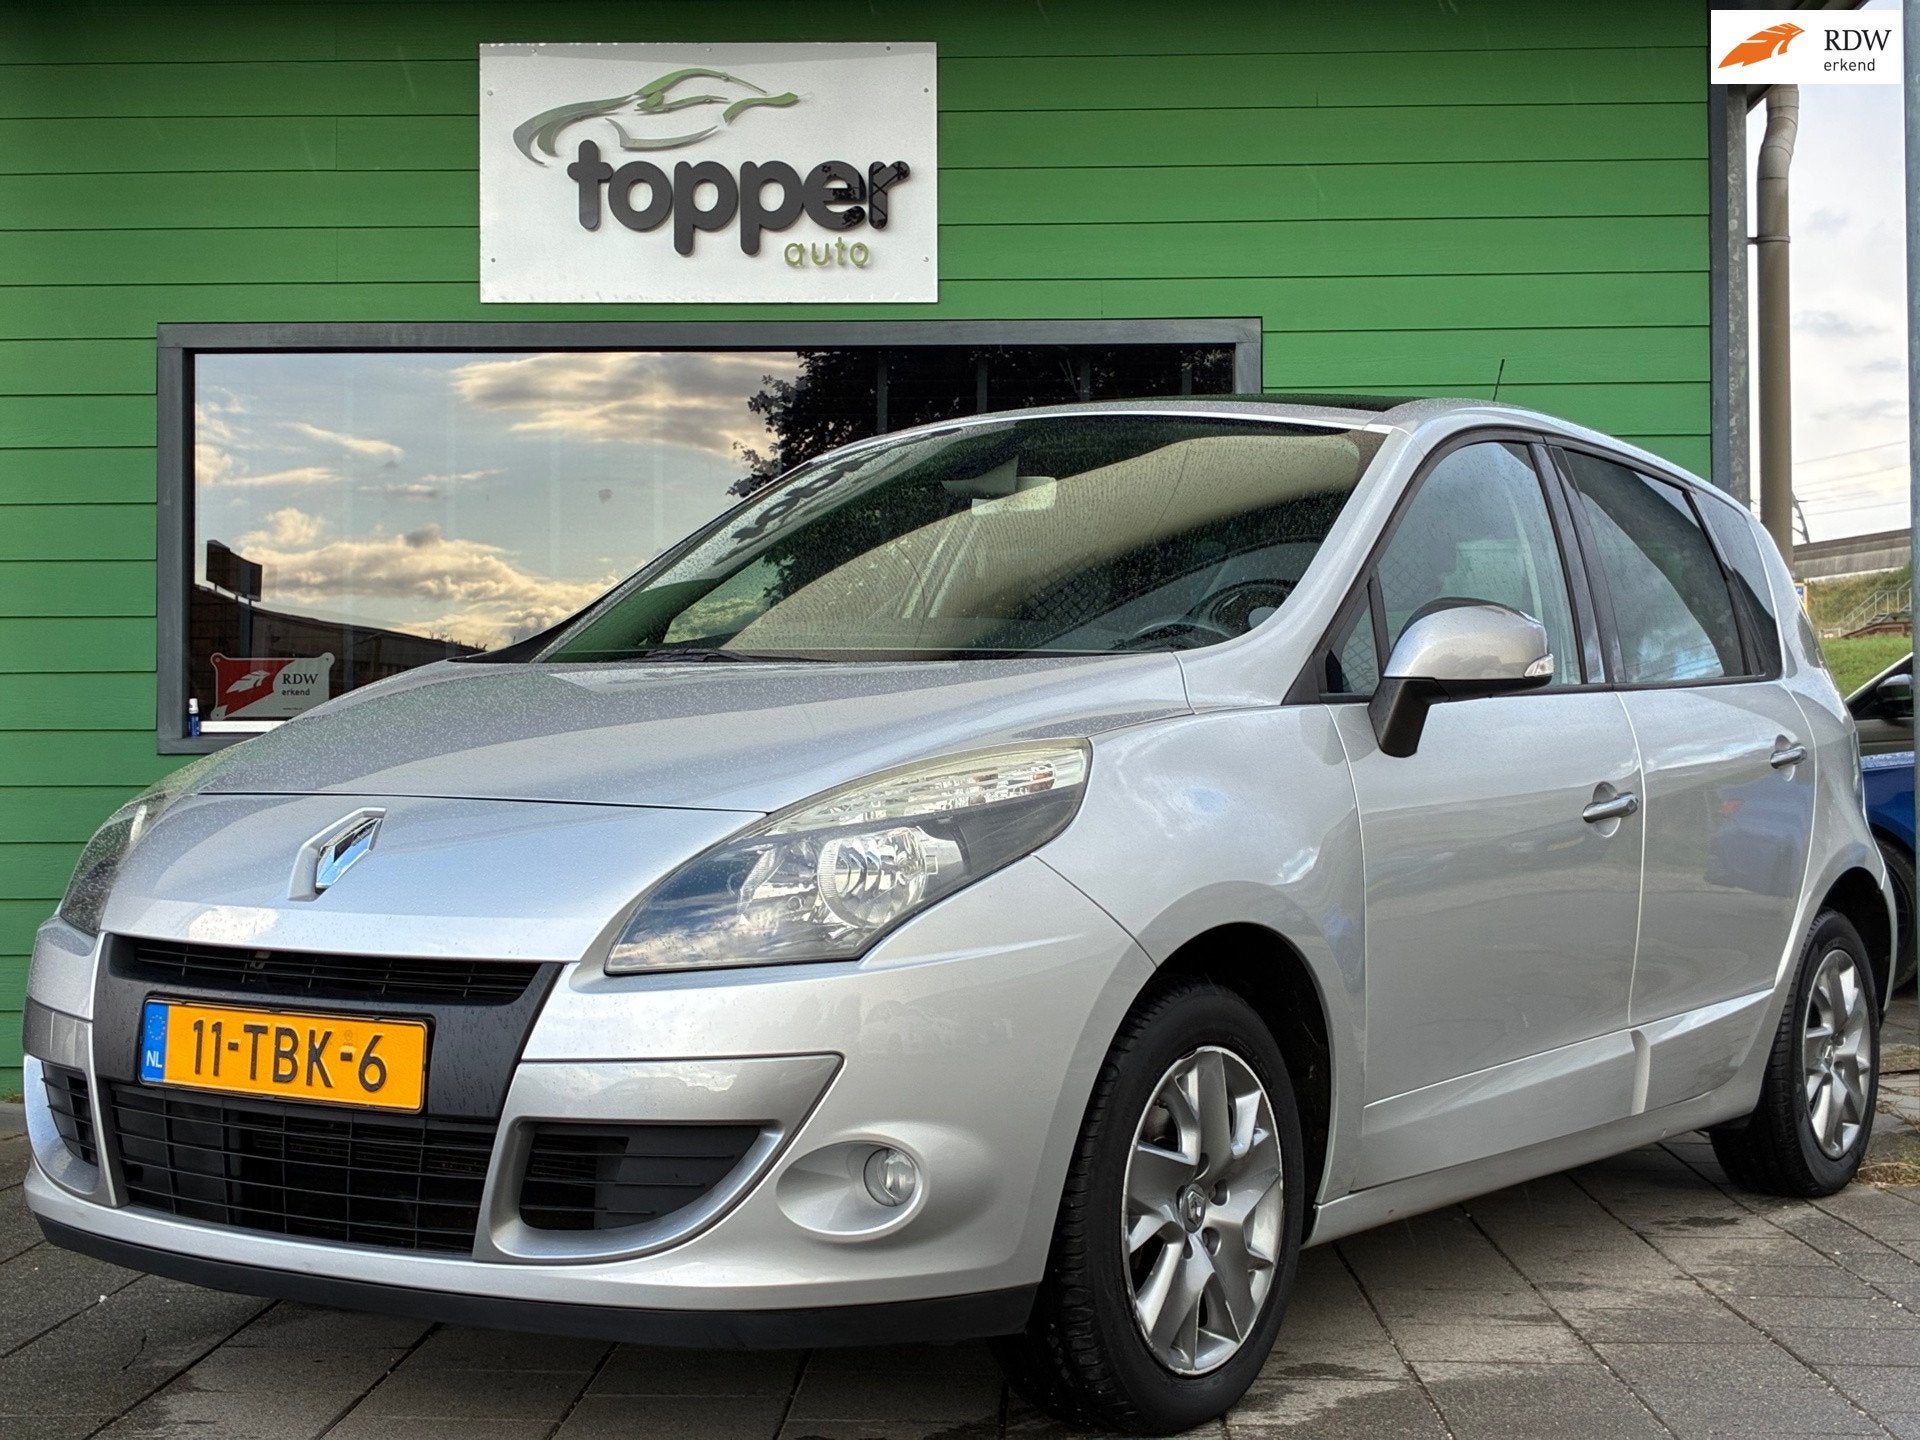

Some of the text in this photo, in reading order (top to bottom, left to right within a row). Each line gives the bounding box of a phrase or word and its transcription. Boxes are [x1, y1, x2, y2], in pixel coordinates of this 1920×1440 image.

[567, 139, 910, 256] topper
[784, 236, 870, 267] auto
[282, 673, 318, 685] RDW
[282, 688, 310, 696] erkend
[146, 1050, 163, 1069] NL
[192, 1019, 387, 1093] 11-TBK-6
